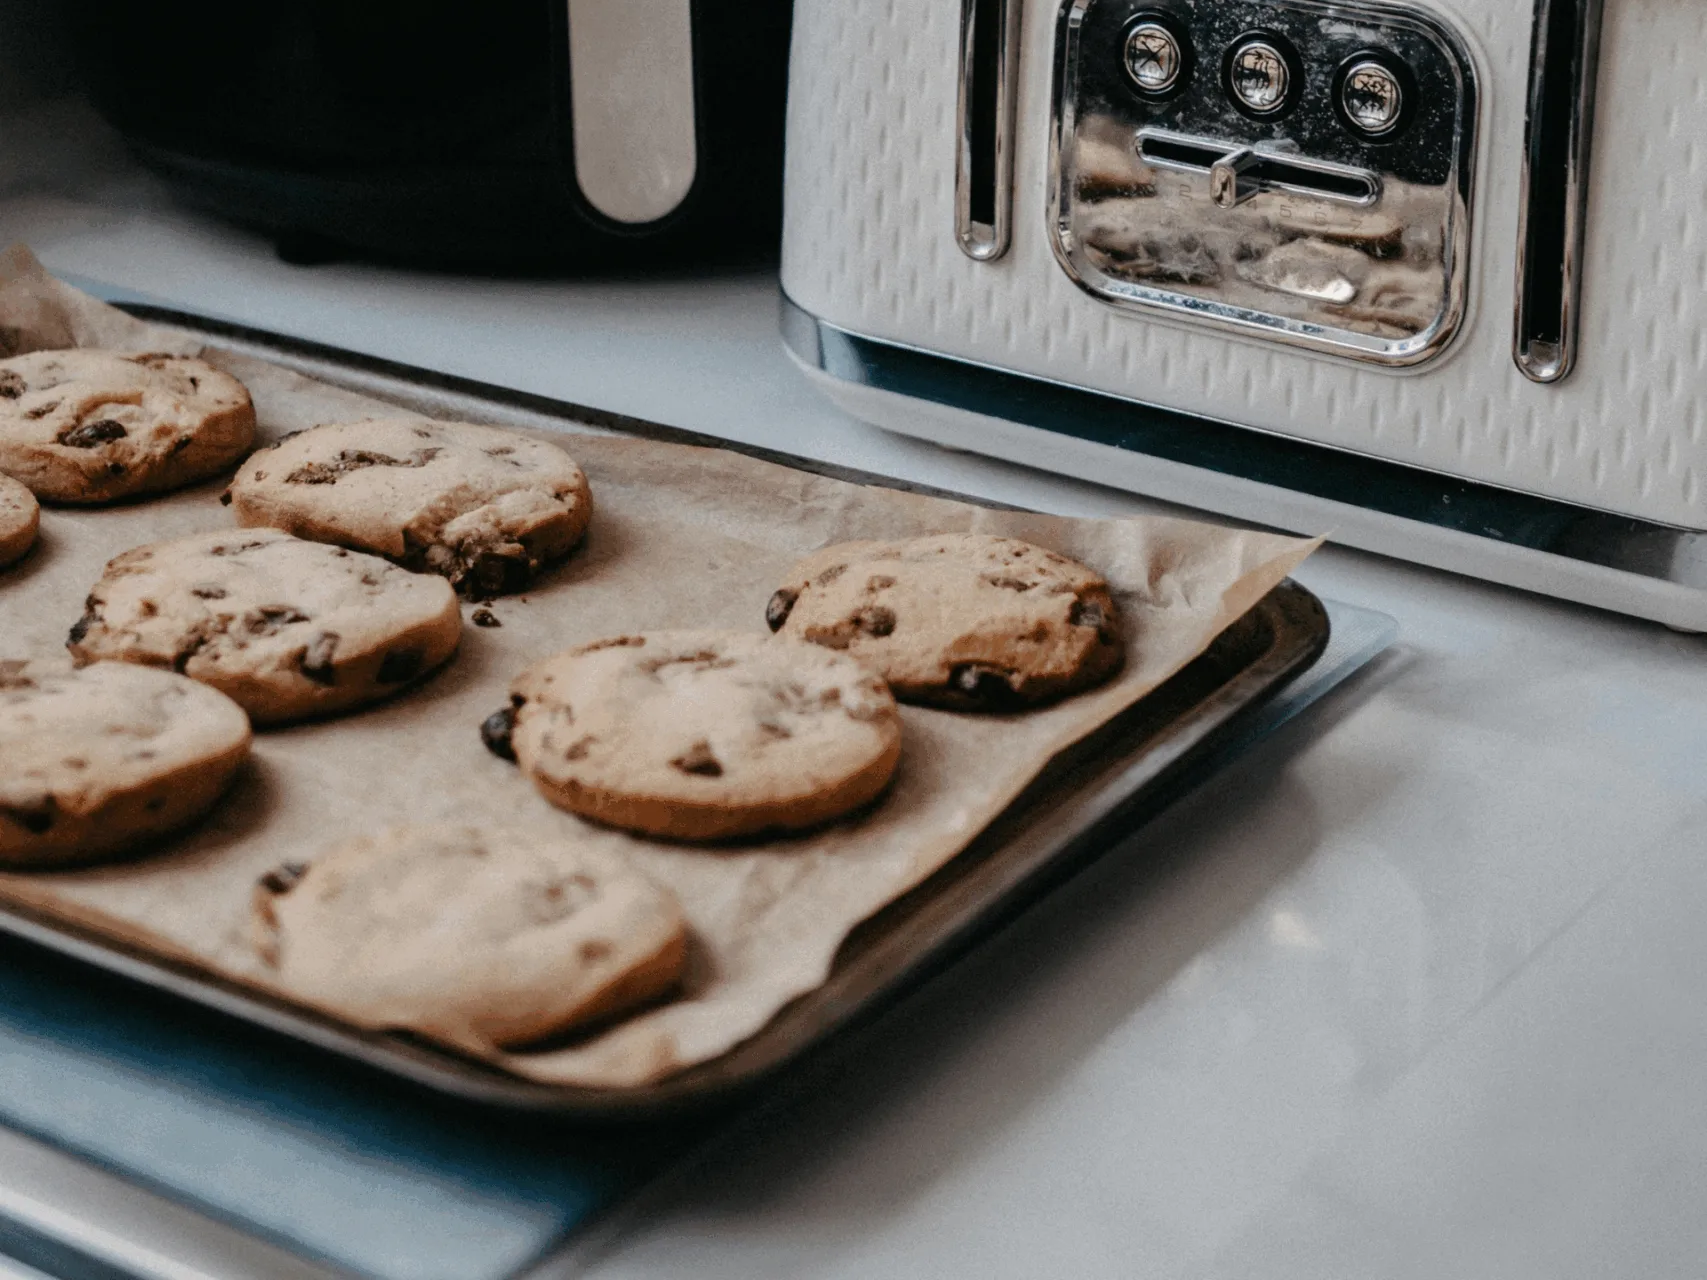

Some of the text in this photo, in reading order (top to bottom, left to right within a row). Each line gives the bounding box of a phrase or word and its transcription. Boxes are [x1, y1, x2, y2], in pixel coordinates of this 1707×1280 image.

[1179, 183, 1193, 201] 2
[1279, 204, 1292, 219] 5
[1314, 211, 1327, 226] 6
[1350, 218, 1363, 233] 7
